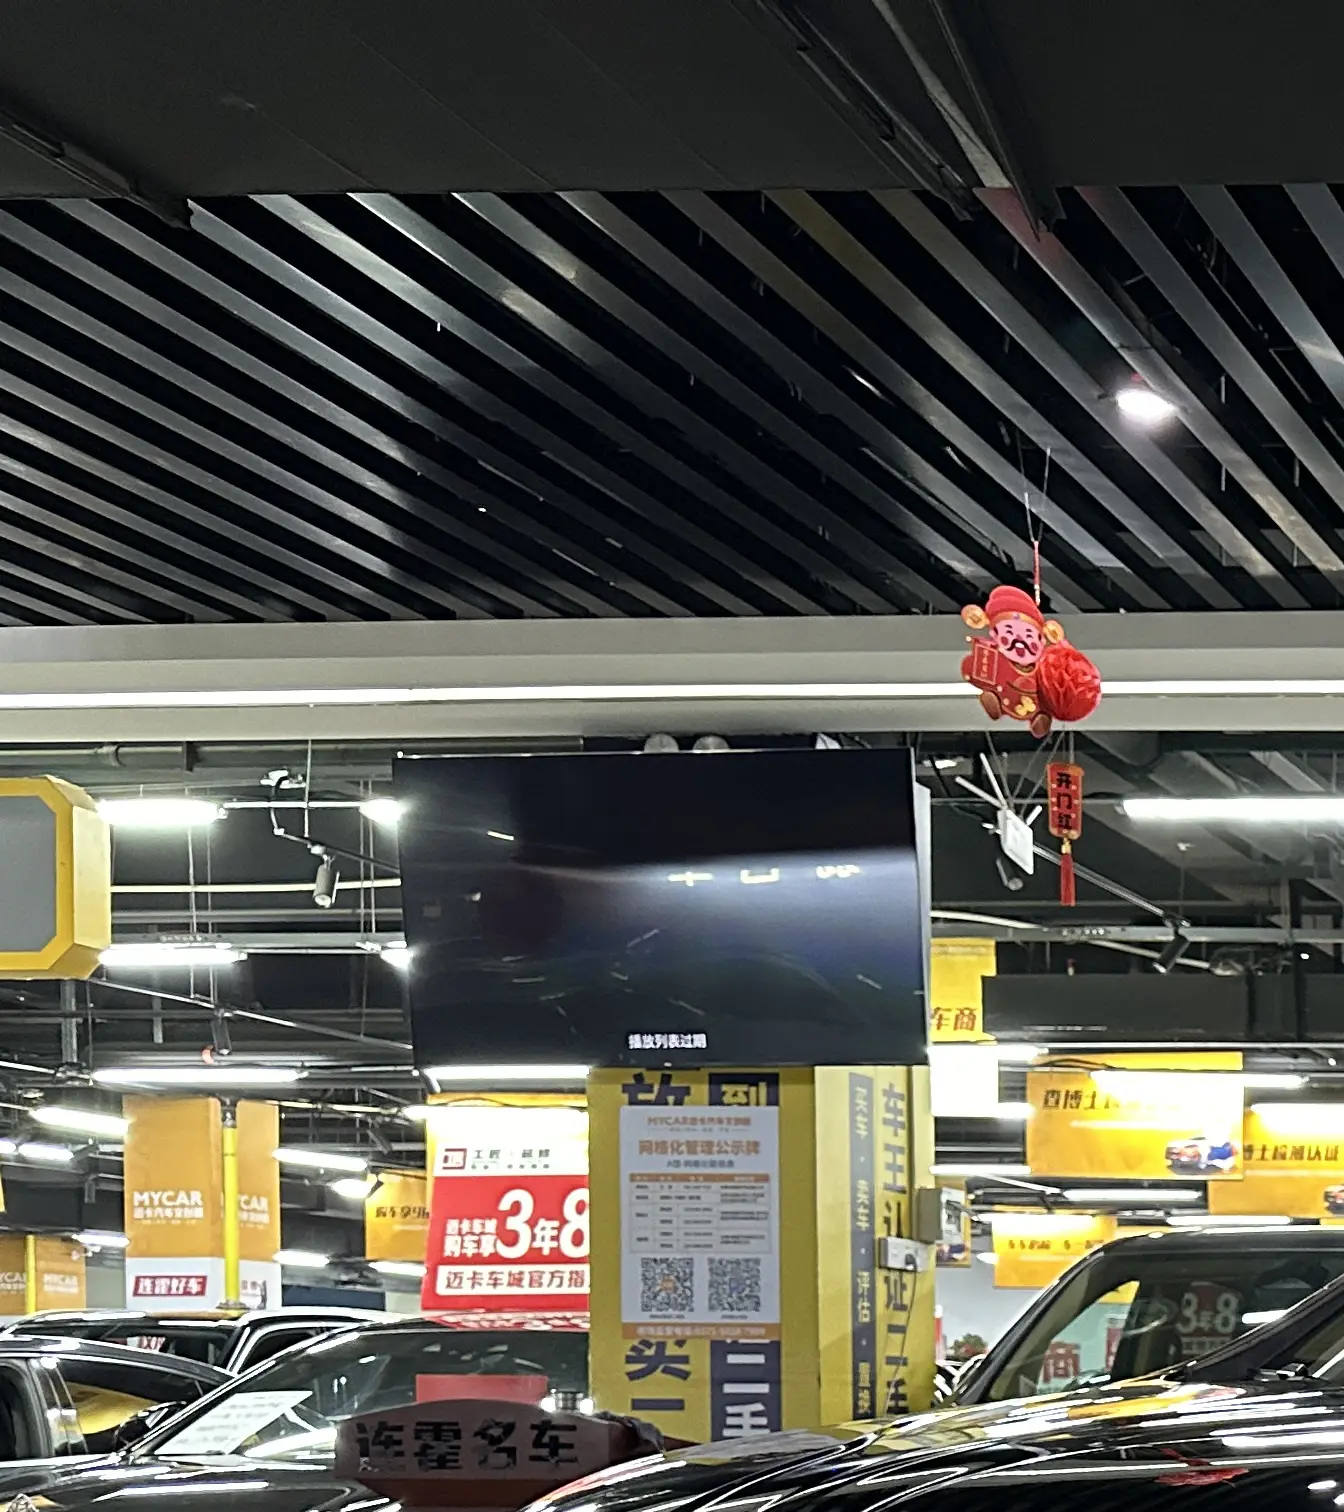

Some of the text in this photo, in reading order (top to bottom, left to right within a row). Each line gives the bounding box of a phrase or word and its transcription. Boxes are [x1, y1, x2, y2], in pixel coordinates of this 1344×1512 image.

[1055, 772, 1073, 830] 开门红
[628, 1033, 707, 1049] 播放列表过期
[133, 1190, 204, 1207] MYCAR
[445, 1269, 590, 1290] 迈卡车城官方指
